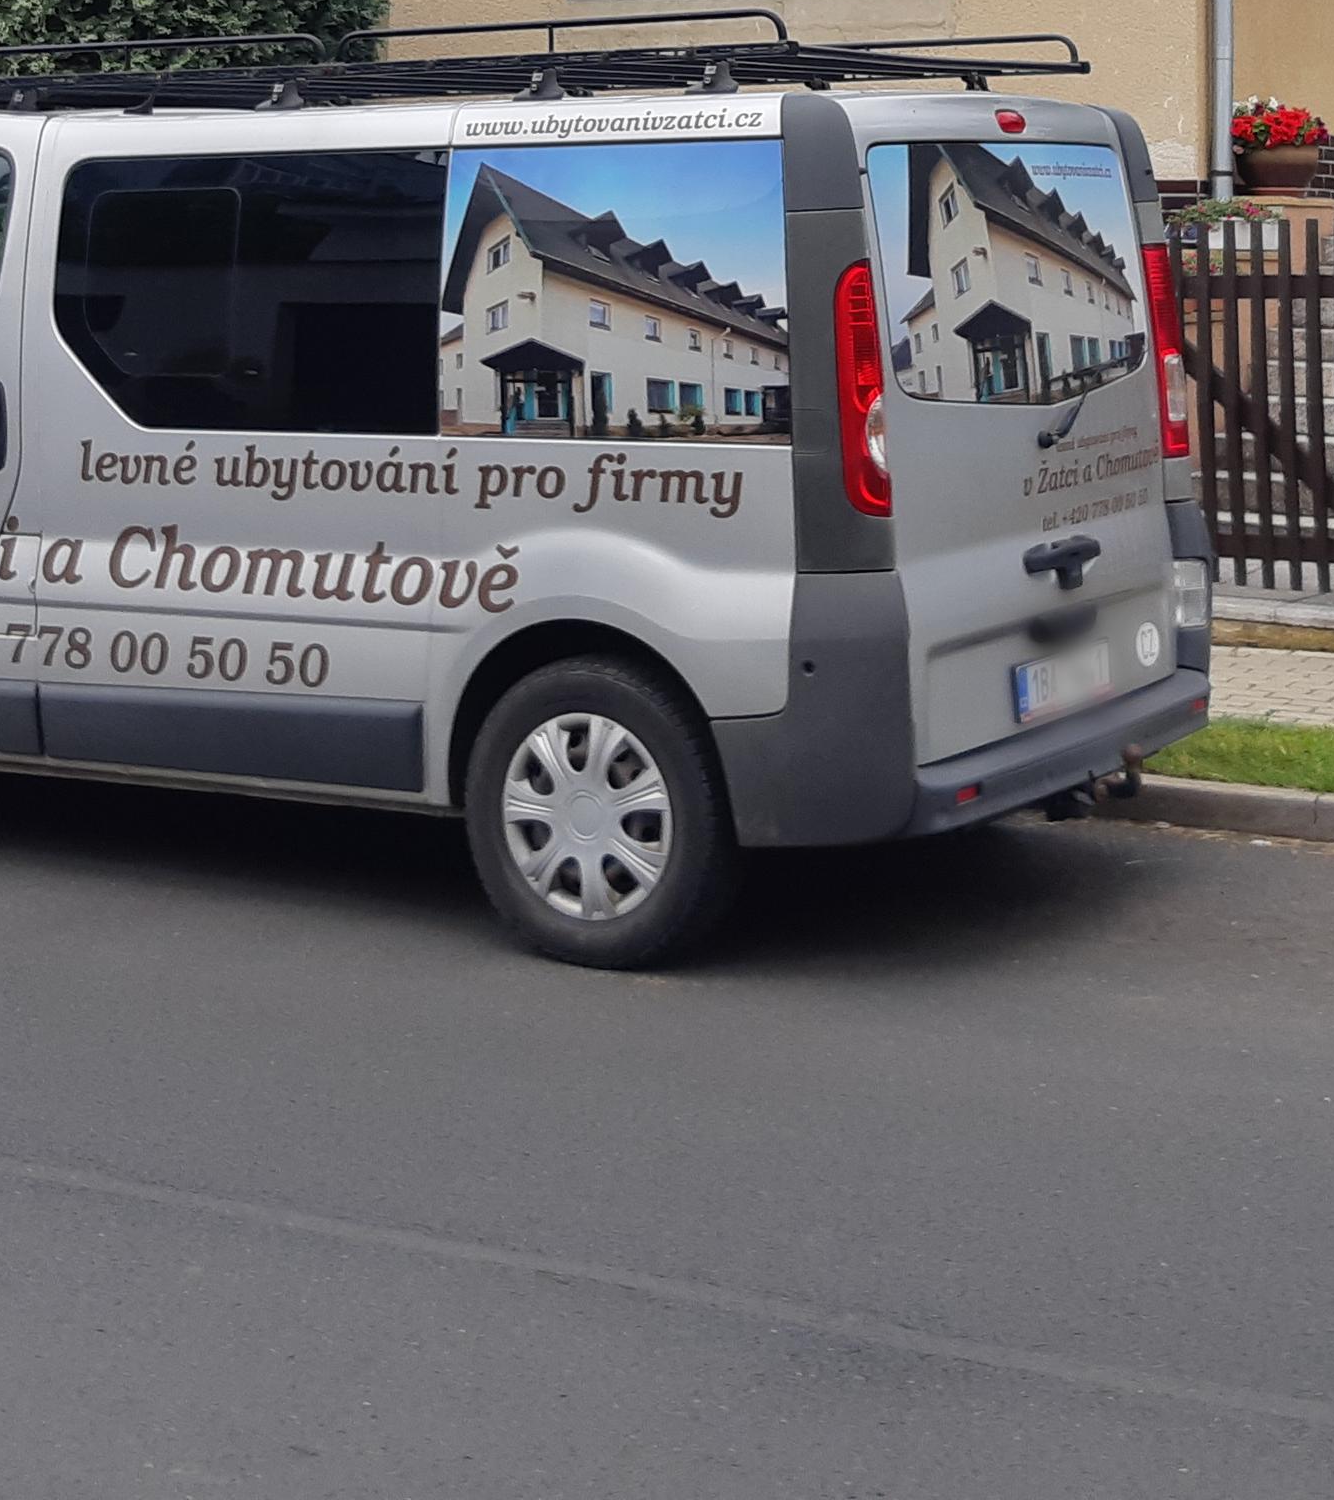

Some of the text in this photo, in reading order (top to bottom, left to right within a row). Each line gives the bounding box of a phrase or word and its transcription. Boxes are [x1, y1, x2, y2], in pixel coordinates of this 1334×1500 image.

[466, 108, 763, 139] www.ubytovanivzatci.cz
[81, 439, 744, 518] levné ubytování pro firmy
[1023, 476, 1033, 496] v
[1037, 459, 1079, 494] Žatci
[1083, 463, 1092, 483] a
[42, 538, 84, 585] a
[109, 524, 519, 613] Chomutově
[7, 623, 92, 669] 778
[110, 630, 168, 675] 00
[187, 636, 248, 681] 50
[266, 642, 329, 688] 50
